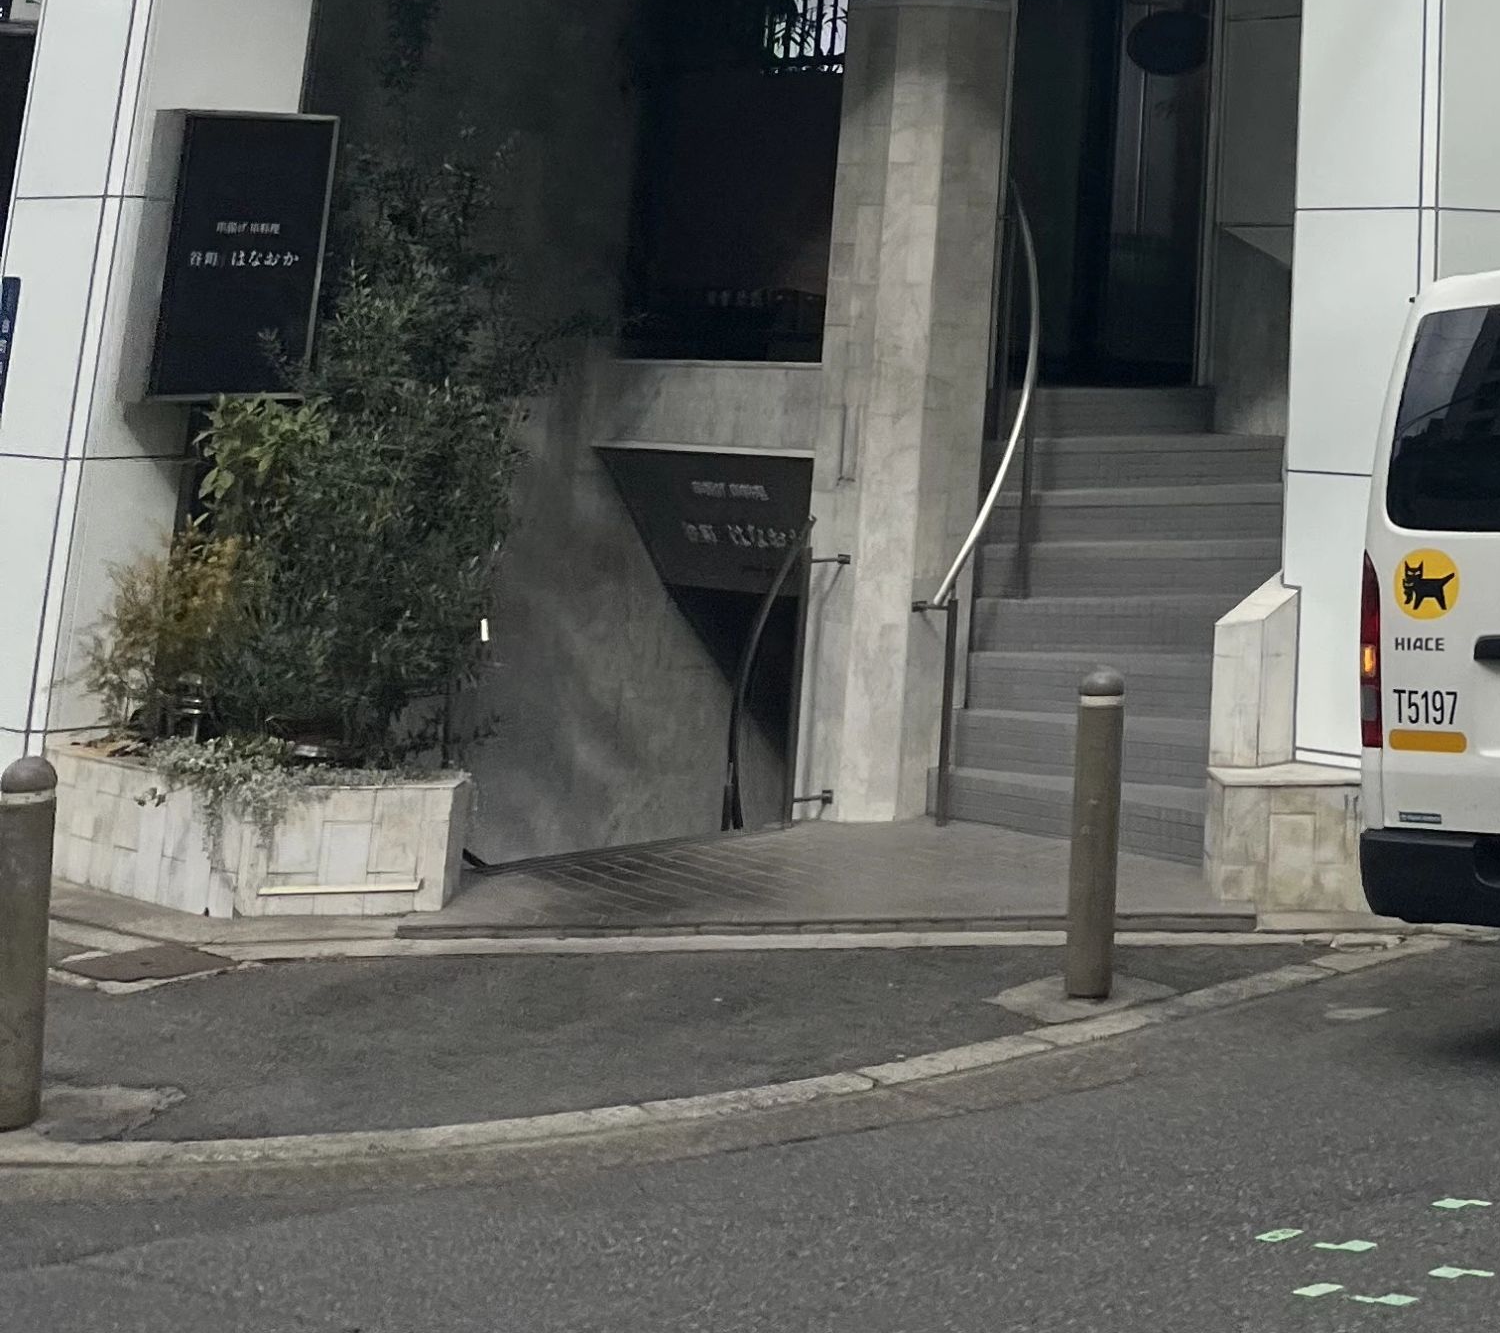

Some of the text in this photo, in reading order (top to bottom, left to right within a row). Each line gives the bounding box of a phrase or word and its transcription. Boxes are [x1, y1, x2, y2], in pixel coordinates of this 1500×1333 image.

[231, 250, 300, 267] はなおか
[1394, 637, 1446, 652] HIACE
[1392, 688, 1458, 726] T5197
